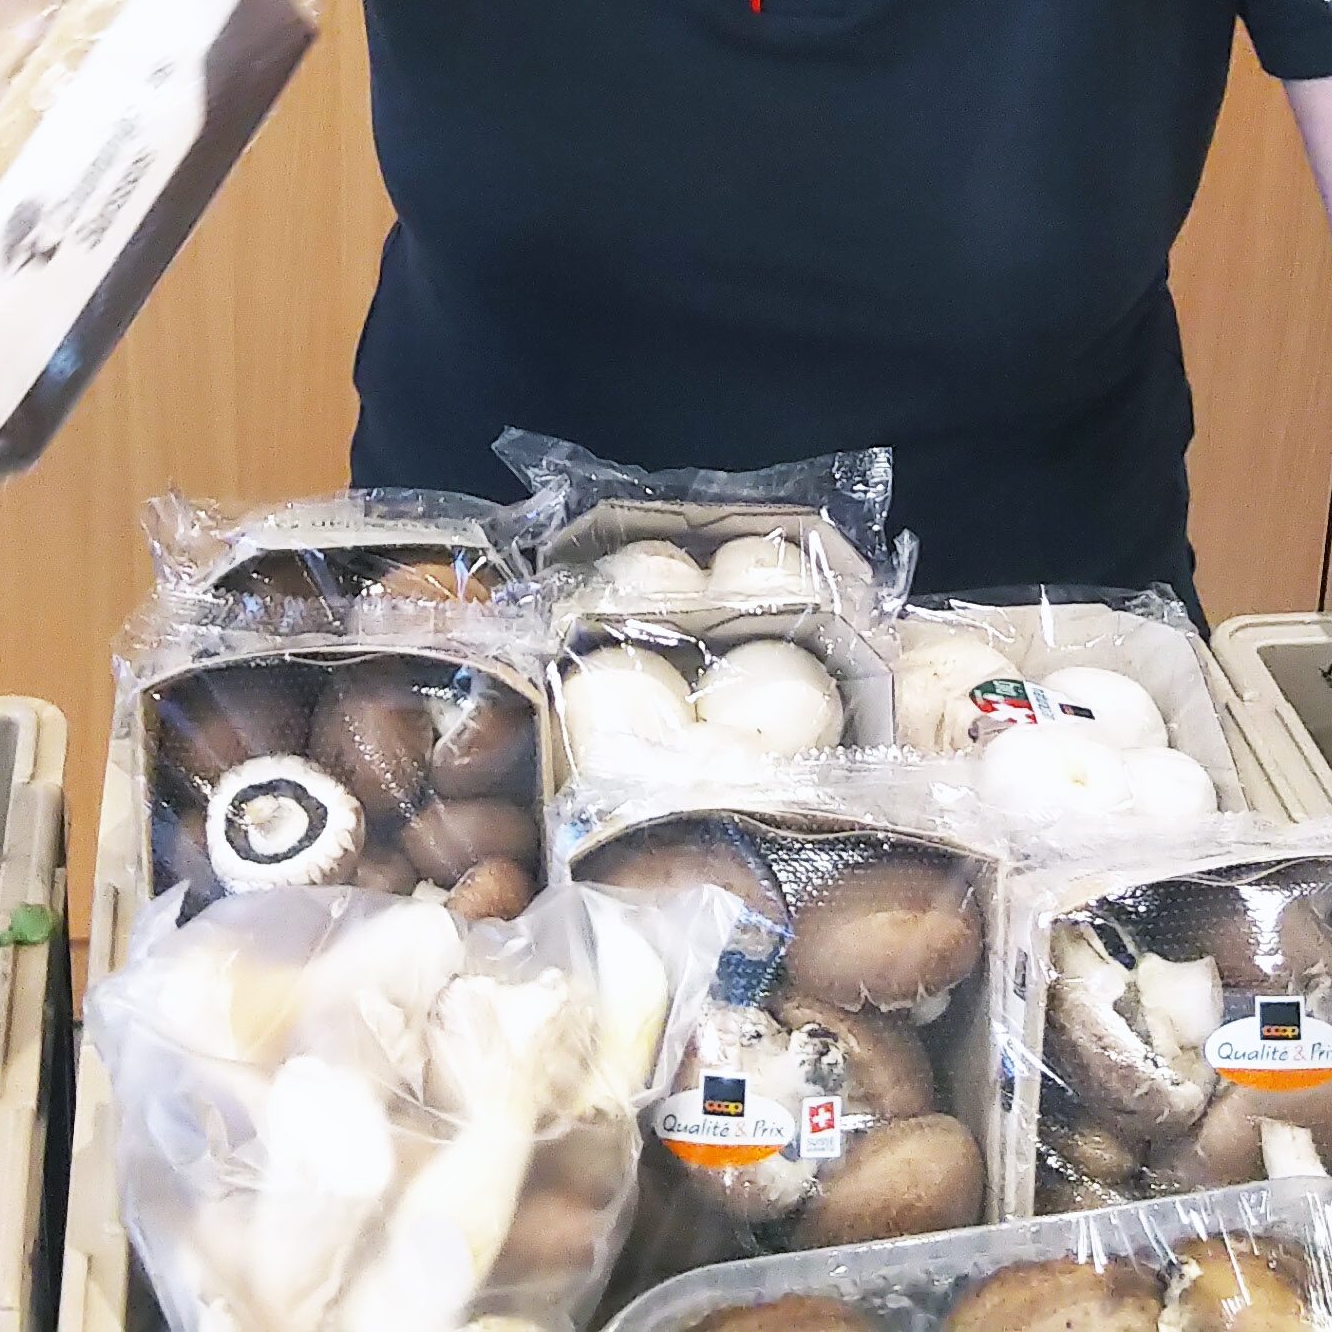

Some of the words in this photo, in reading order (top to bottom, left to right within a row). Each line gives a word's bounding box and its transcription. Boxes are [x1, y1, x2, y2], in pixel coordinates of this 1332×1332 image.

[1262, 1025, 1299, 1039] coop
[1218, 1041, 1289, 1062] Qualité
[1293, 1045, 1306, 1061] &
[704, 1100, 743, 1116] coop
[663, 1113, 730, 1138] Qualité
[751, 1119, 785, 1139] Prix
